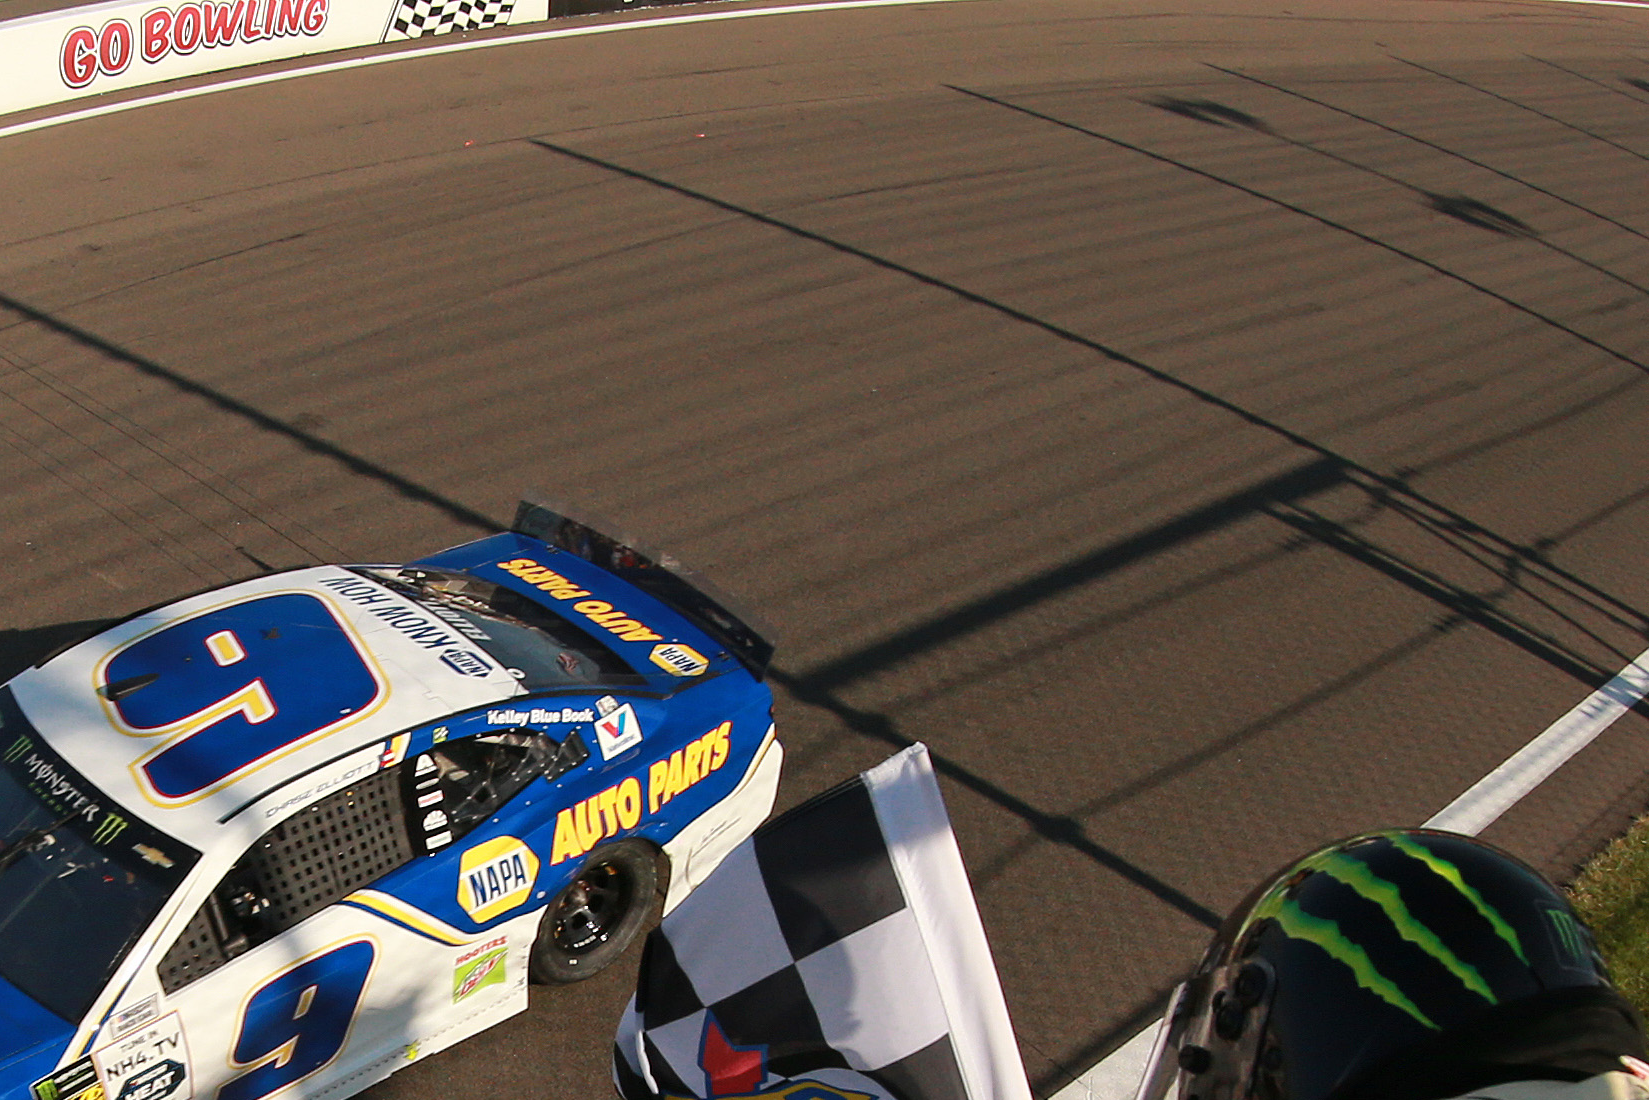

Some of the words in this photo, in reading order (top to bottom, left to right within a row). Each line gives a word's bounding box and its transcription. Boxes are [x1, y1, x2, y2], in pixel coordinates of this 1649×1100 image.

[59, 19, 135, 89] GO
[141, 0, 330, 64] BOWLING
[318, 577, 393, 606] HOW
[496, 557, 593, 600] PARTS
[368, 605, 459, 650] KNOW
[572, 599, 665, 642] AUTO
[449, 649, 485, 678] NAPA
[658, 646, 702, 674] NAPA
[92, 588, 391, 810] 9
[486, 709, 530, 727] Kelley
[530, 708, 561, 724] Blue
[561, 707, 595, 724] Book
[24, 753, 100, 822] MONSTER
[549, 776, 642, 866] AUTO
[648, 720, 733, 814] PARTS
[469, 853, 528, 909] NAPA
